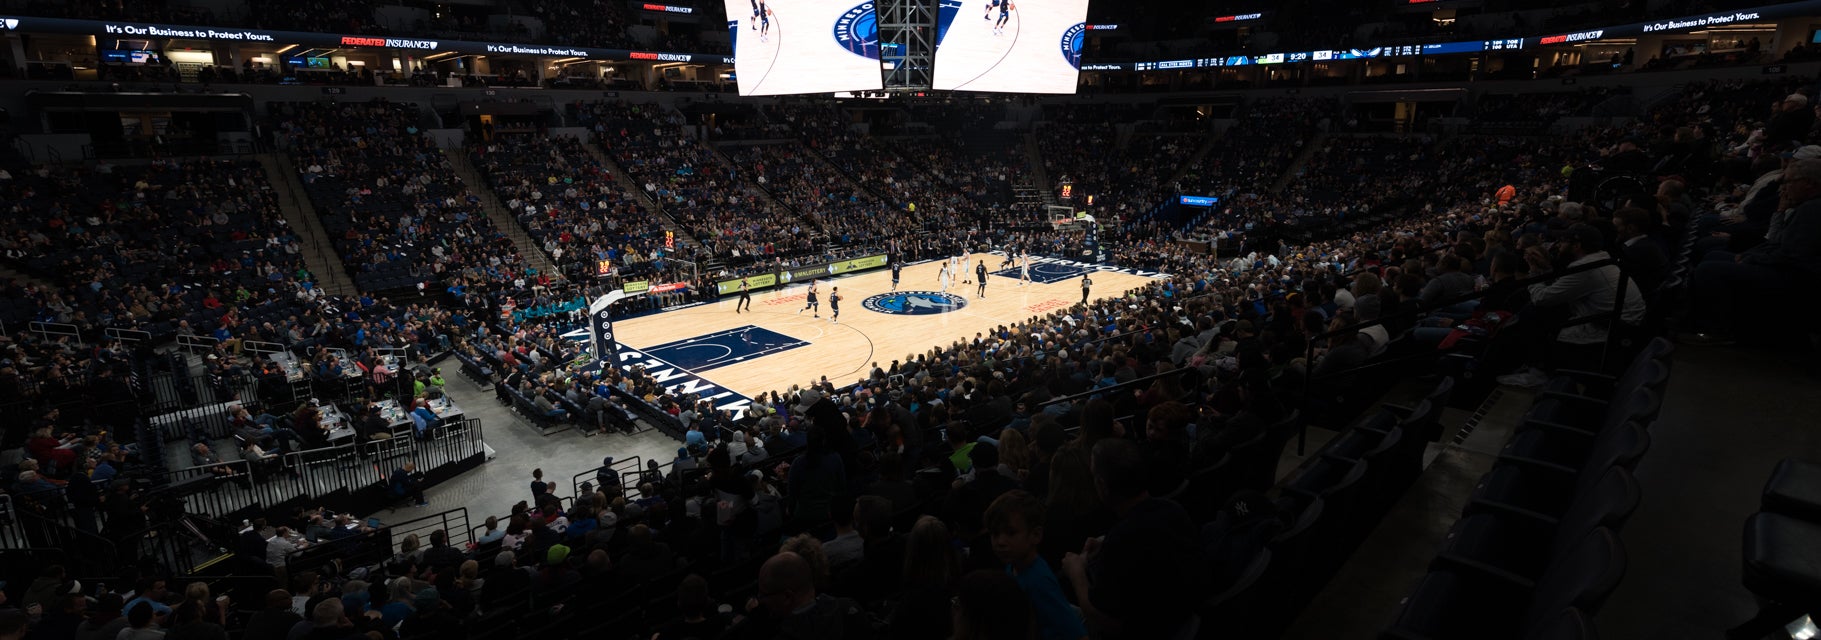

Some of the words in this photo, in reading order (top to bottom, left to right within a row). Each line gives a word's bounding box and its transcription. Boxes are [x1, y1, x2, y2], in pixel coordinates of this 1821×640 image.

[1643, 24, 1653, 32] It's
[1668, 20, 1697, 29] Business
[1707, 15, 1734, 25] Protect
[1735, 12, 1760, 21] Yours.
[106, 24, 123, 34] It's
[125, 26, 147, 36] Our
[150, 26, 194, 38] Business
[195, 30, 206, 38] to
[208, 30, 243, 39] Protect
[244, 31, 274, 41] Yours.
[341, 36, 386, 47] FEDERATED
[385, 38, 430, 49] INSURANCE
[498, 45, 512, 53] Our
[513, 46, 540, 54] Business
[548, 48, 569, 56] Protect
[630, 51, 658, 60] FEDERATED
[657, 52, 685, 61] INSURANCE
[1290, 52, 1306, 60] 9:20
[793, 267, 826, 278] @MNLOTTERY
